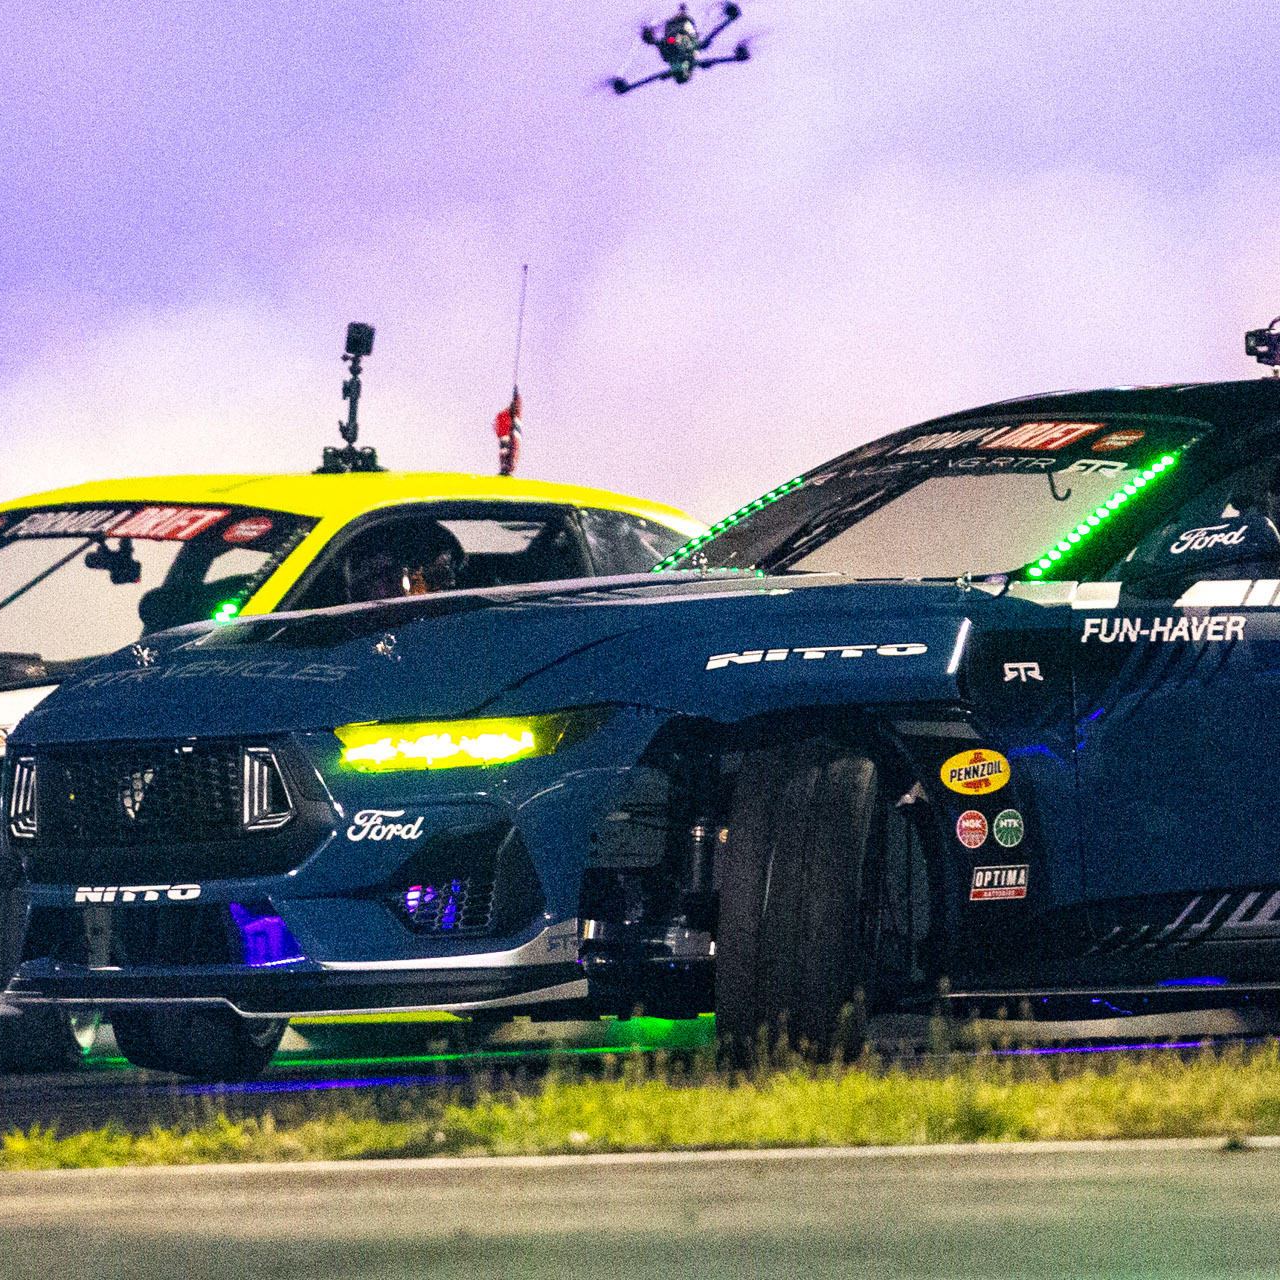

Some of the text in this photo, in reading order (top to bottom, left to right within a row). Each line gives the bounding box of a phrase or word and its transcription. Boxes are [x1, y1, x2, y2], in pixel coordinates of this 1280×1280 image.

[982, 423, 1100, 450] DRIFT
[108, 507, 227, 538] DRIFT
[1170, 524, 1245, 555] Ford
[1081, 617, 1245, 644] FUN-HAVER
[705, 643, 928, 671] NITTO
[950, 760, 1003, 782] PENNZOIL
[347, 809, 424, 842] Ford
[975, 870, 1026, 887] OPTIMA
[75, 883, 202, 903] NITTO
